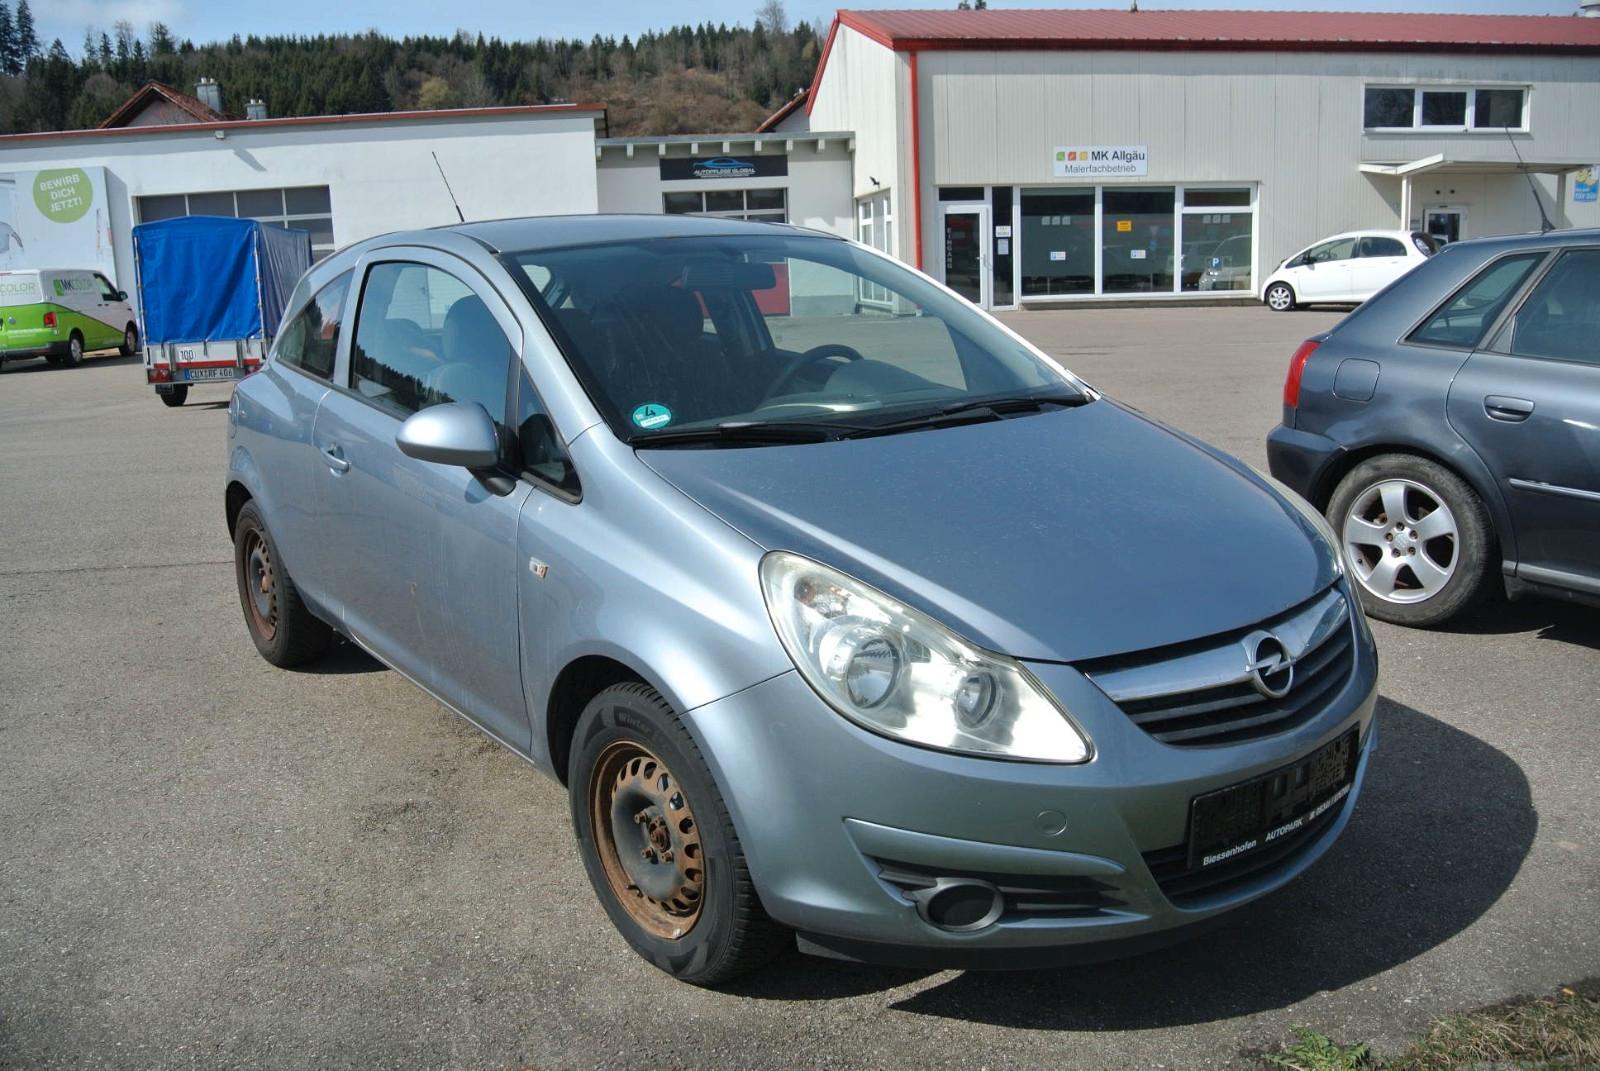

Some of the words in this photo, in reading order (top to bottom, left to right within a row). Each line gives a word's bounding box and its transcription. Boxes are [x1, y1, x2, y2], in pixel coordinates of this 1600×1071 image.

[1091, 151, 1109, 161] MK
[1112, 150, 1145, 163] Allgäu
[1065, 164, 1136, 174] Malerfachbetrieb
[40, 174, 80, 191] BEWIRB
[51, 186, 75, 200] DICH
[50, 197, 82, 212] JETZT!
[179, 350, 194, 360] 100
[645, 406, 656, 417] 4
[1203, 840, 1257, 866] Biessenhofen
[1265, 817, 1304, 842] AUTOPARK
